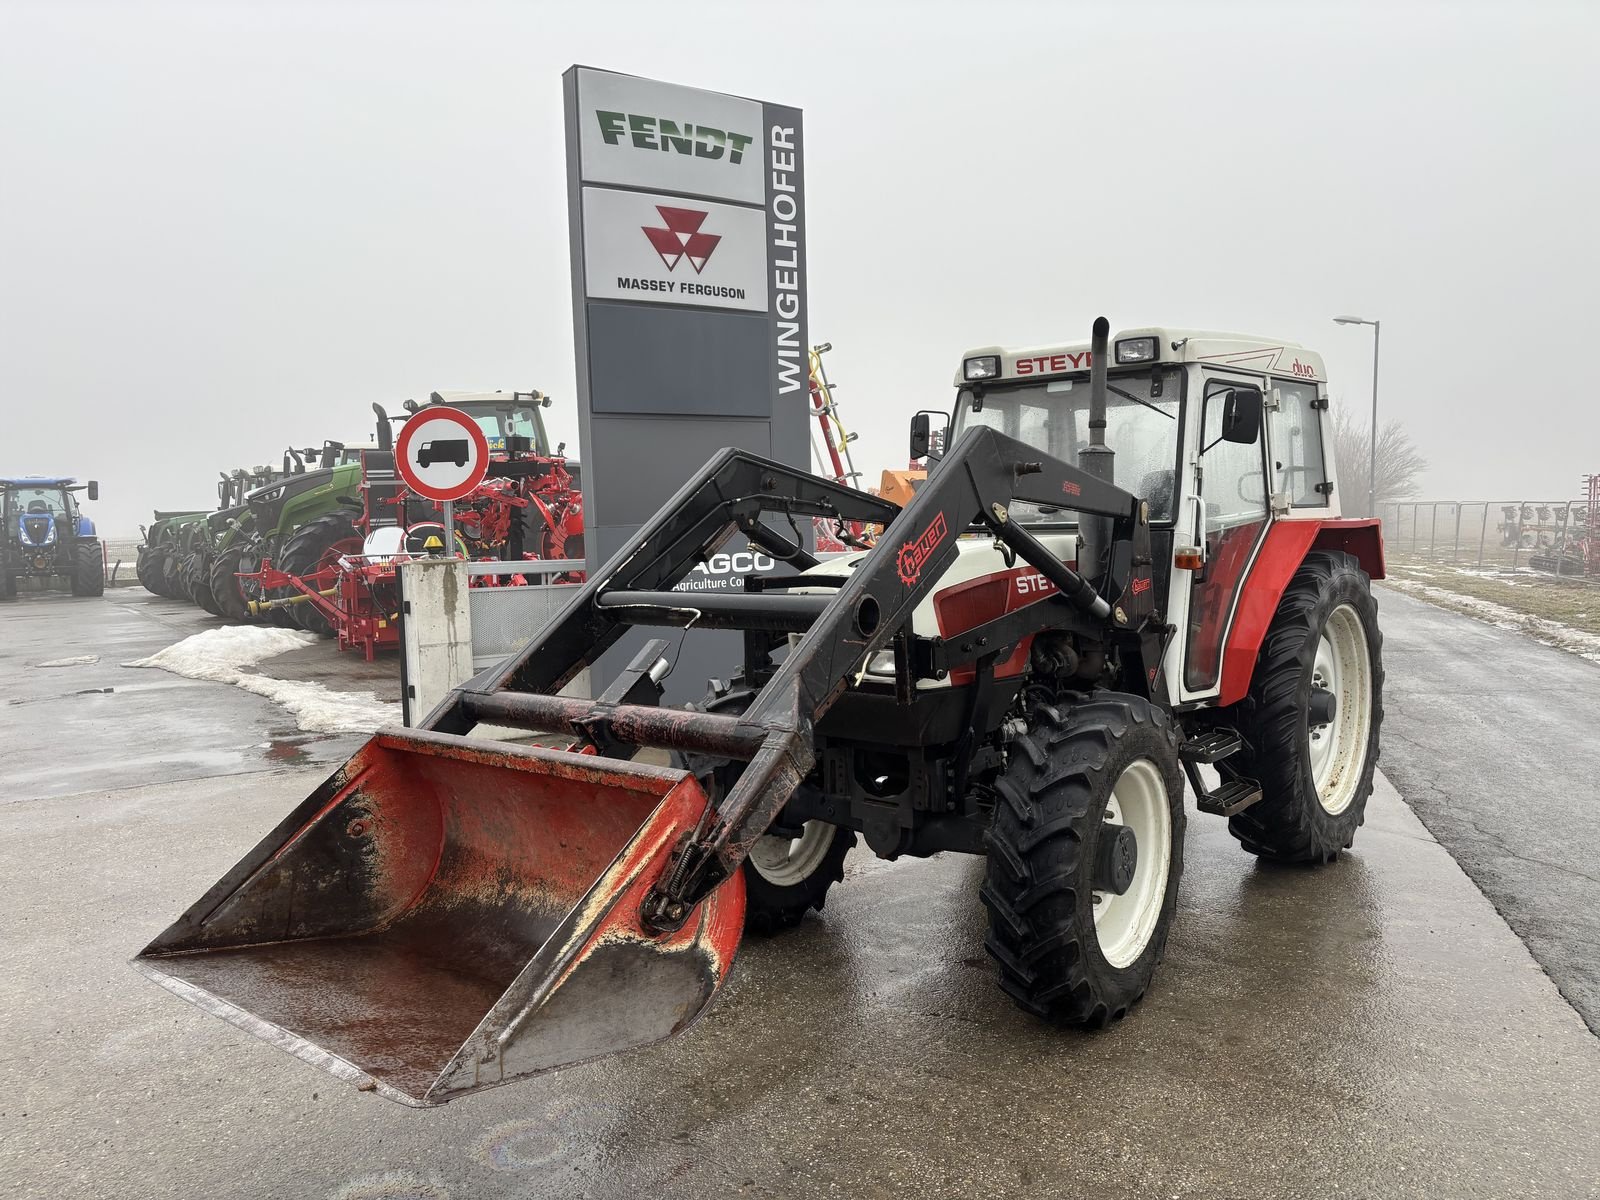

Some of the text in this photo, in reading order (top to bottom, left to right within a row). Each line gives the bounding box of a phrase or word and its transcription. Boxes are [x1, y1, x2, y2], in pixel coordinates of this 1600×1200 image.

[595, 109, 753, 165] FENDT
[772, 124, 801, 395] WINGELHOFER
[617, 277, 746, 300] MASSEY FERGUSON
